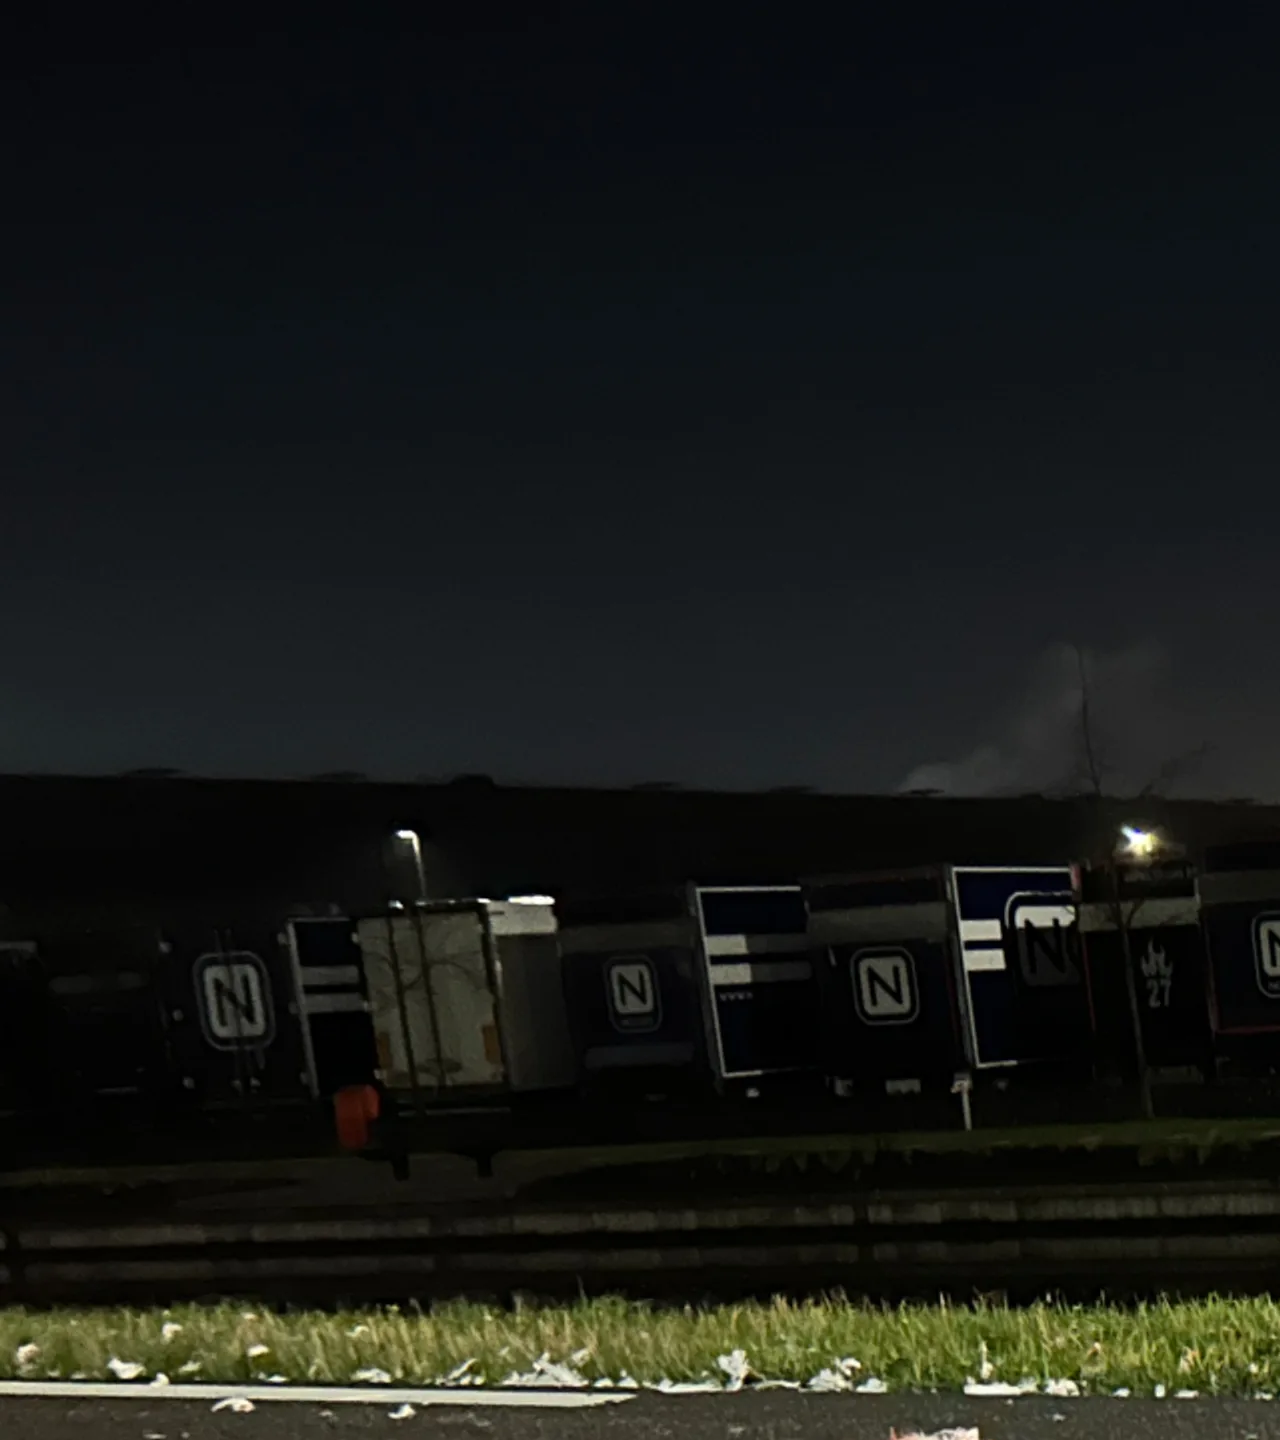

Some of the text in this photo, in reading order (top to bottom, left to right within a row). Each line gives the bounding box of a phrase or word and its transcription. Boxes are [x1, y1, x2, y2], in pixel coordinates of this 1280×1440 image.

[213, 974, 257, 1027] N
[617, 969, 647, 1006] N
[867, 965, 903, 1006] N
[1146, 978, 1172, 1009] 27
